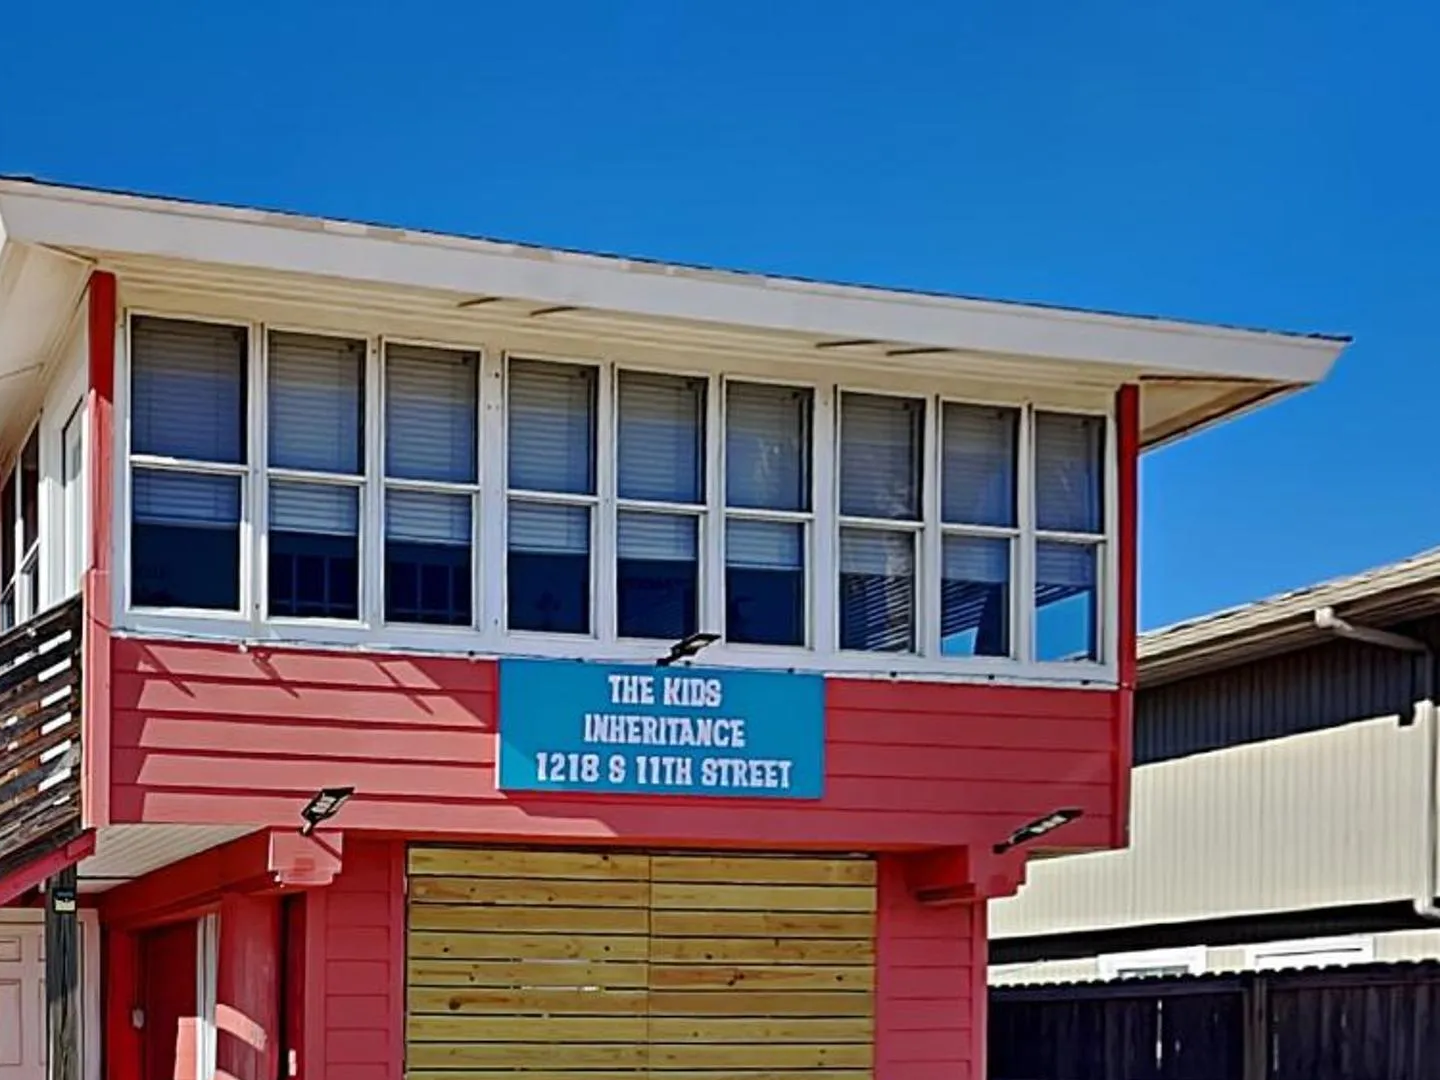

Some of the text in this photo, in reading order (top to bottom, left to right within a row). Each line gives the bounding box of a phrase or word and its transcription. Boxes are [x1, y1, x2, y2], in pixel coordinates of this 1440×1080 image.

[609, 675, 721, 708] THE KIDS
[584, 713, 745, 748] INHERITANCE
[536, 752, 792, 789] 1218 S 11TH STREET
